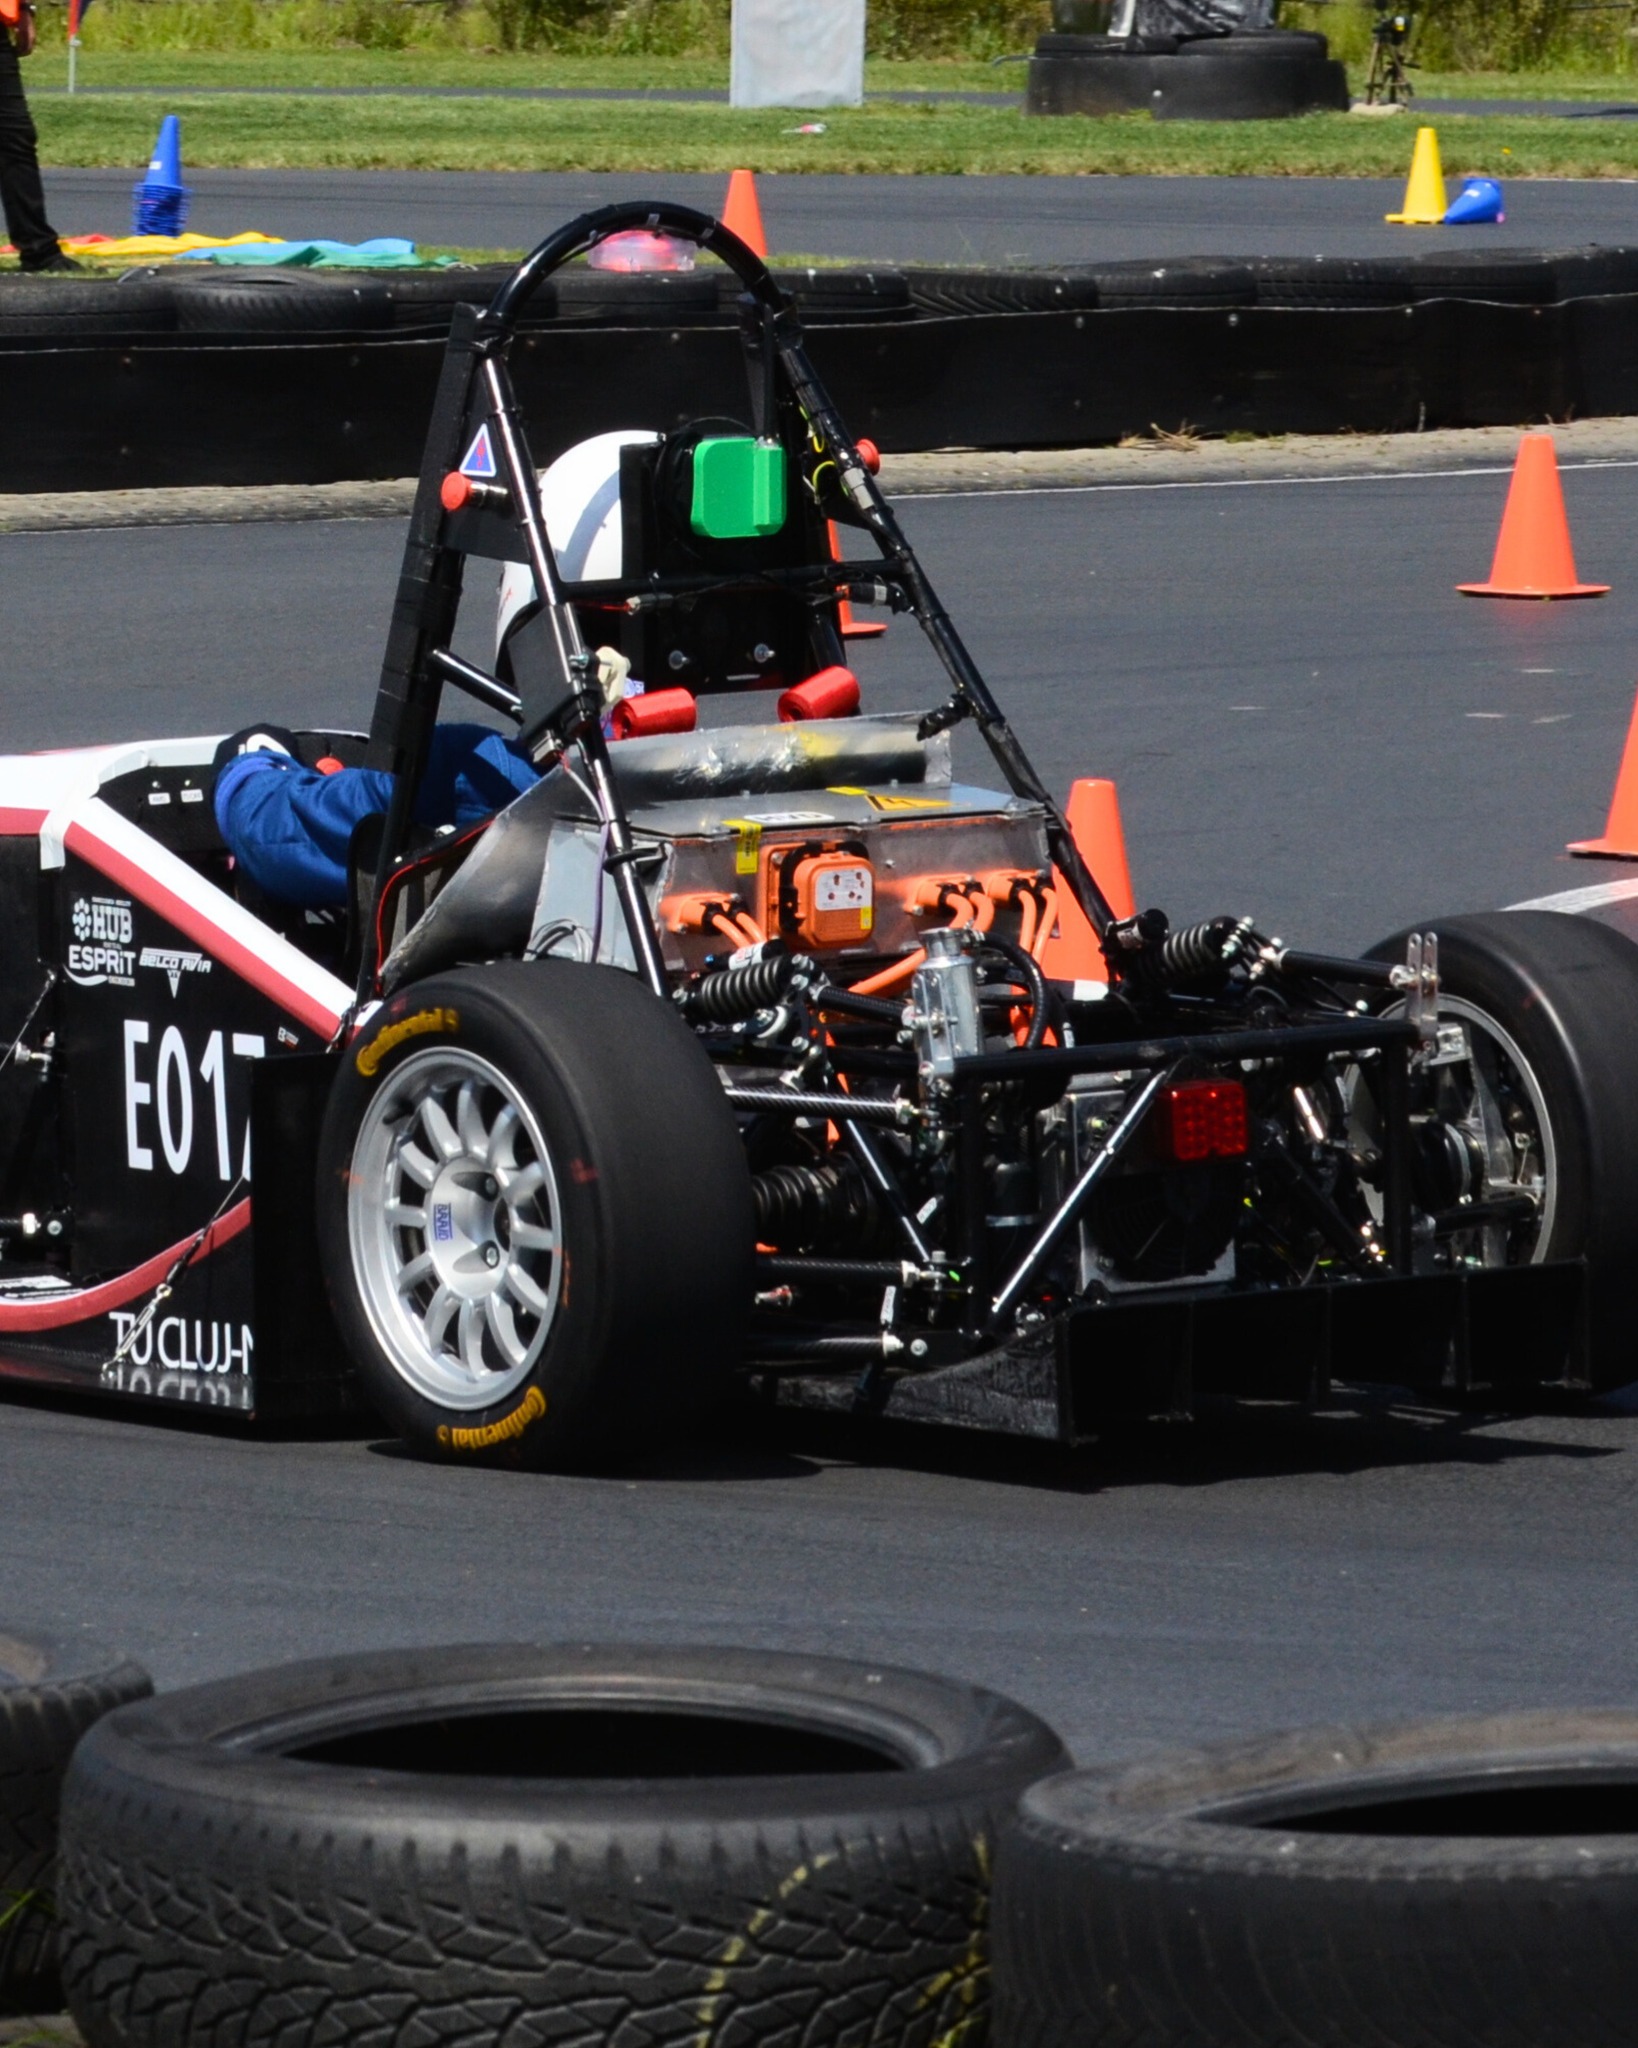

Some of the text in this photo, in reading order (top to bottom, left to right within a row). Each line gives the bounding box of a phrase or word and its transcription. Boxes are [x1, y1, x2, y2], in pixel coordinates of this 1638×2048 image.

[92, 904, 133, 944] HUB
[139, 954, 212, 973] BELCO AVIA
[108, 1311, 153, 1366] TU
